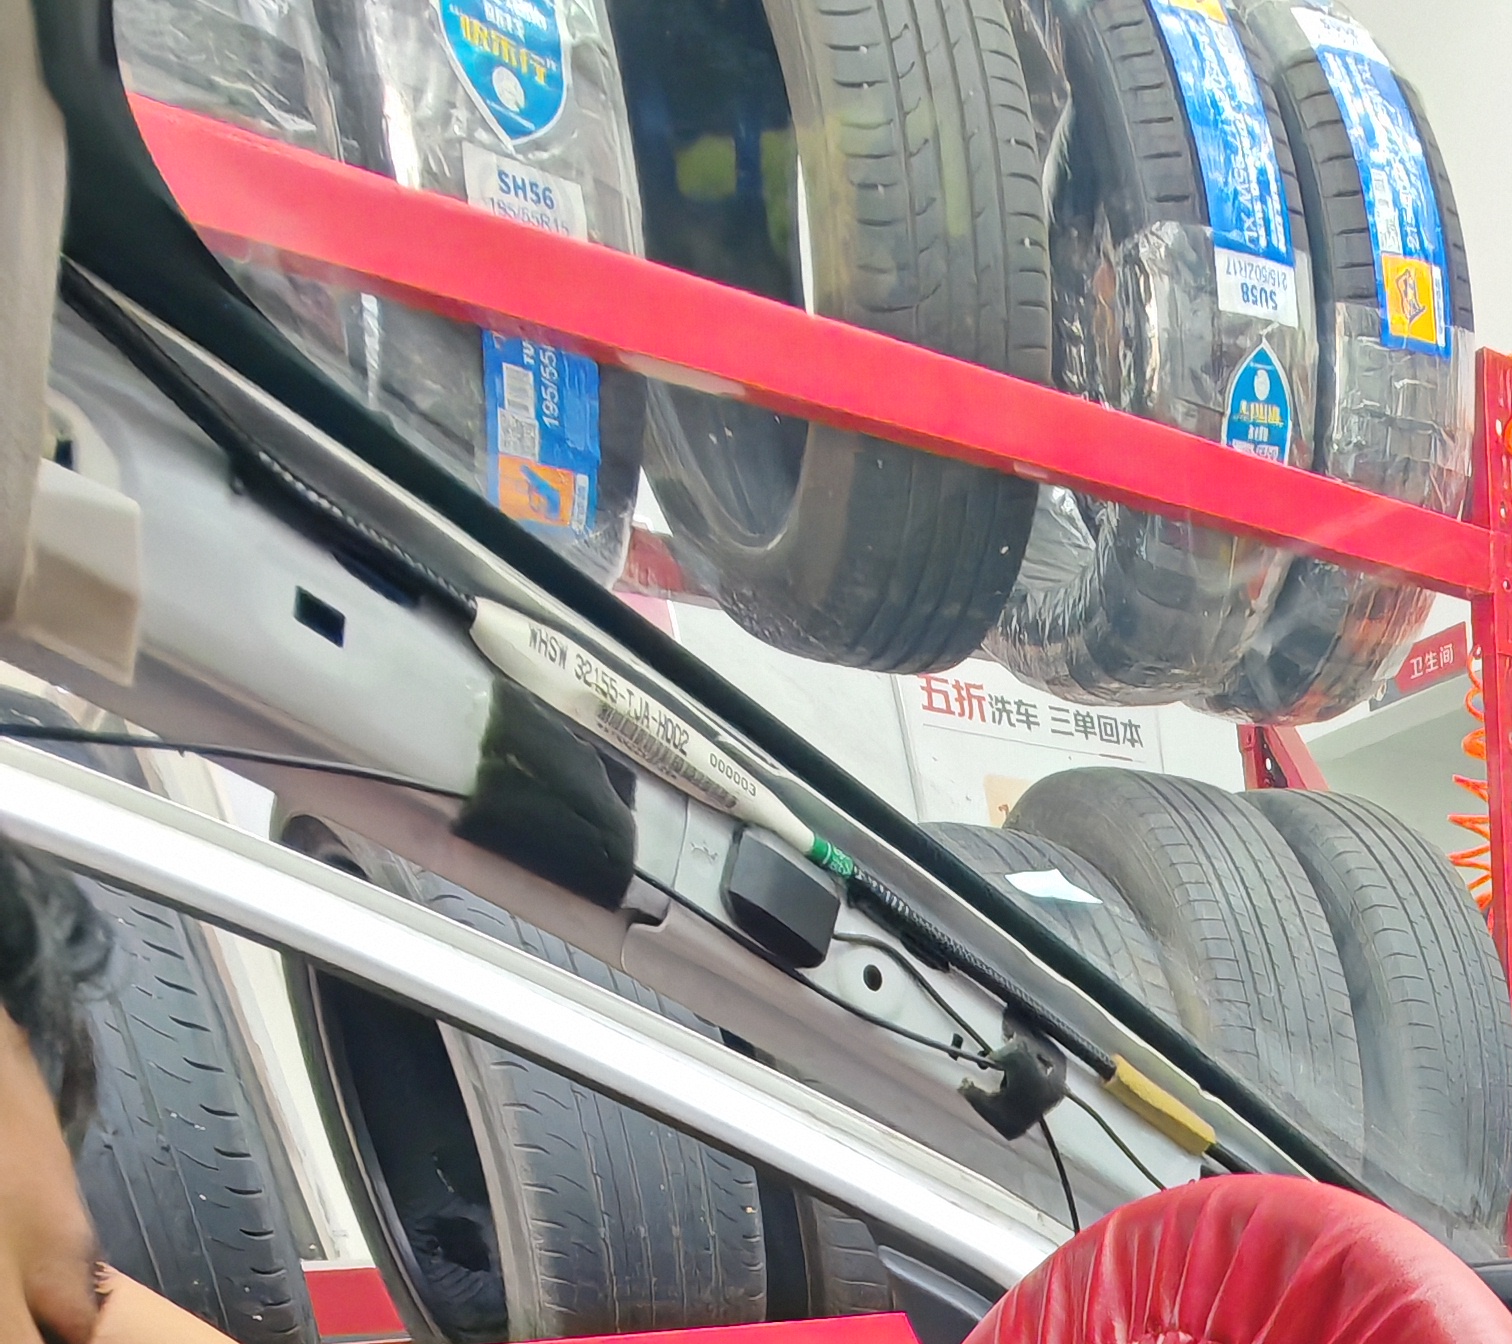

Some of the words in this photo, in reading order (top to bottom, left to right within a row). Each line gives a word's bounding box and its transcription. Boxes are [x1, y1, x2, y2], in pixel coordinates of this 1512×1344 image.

[497, 169, 555, 211] SH56
[1241, 282, 1278, 311] SU58
[540, 344, 559, 429] 195/55
[1409, 643, 1455, 679] 卫生间
[919, 673, 1041, 732] 五折洗车
[1050, 705, 1145, 749] 三单回本
